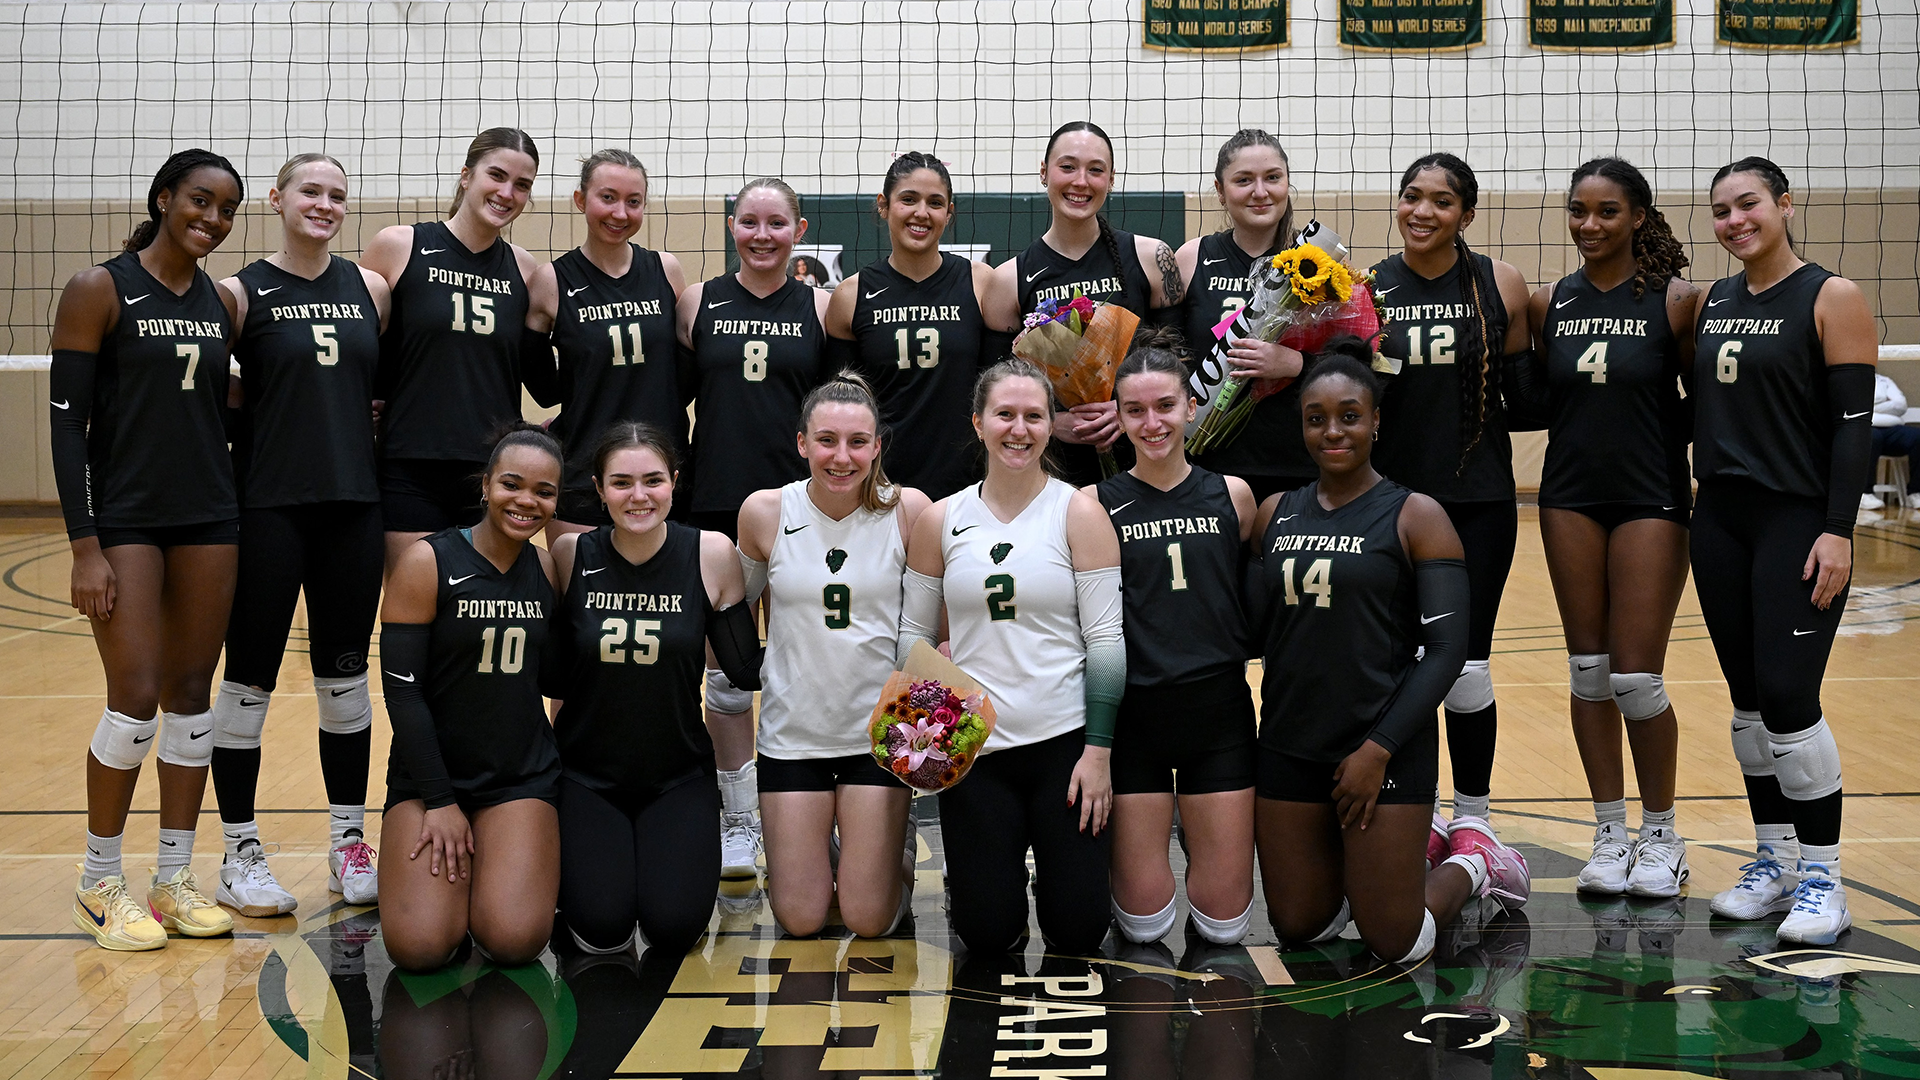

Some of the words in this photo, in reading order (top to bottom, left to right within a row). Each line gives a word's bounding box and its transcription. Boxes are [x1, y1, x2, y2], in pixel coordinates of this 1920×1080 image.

[1177, 21, 1199, 36] NAIA
[1204, 21, 1235, 36] WORLD
[1238, 20, 1272, 36] SERIES
[1372, 19, 1394, 34] NAIA
[1397, 18, 1429, 33] WORLD
[1432, 18, 1467, 33] SERIES
[1535, 18, 1557, 33] 1999
[1564, 18, 1586, 33] NAIA
[1588, 17, 1652, 33] INDEPENDENT
[428, 266, 513, 297] POINTPARK
[1035, 277, 1123, 304] POINTPARK
[1207, 276, 1255, 293] POINT
[270, 303, 364, 321] POINTPARK
[450, 291, 496, 336] 15
[578, 299, 662, 323] POINTPARK
[873, 305, 962, 325] POINTPARK
[136, 319, 223, 339] POINTPARK
[712, 319, 803, 338] POINTPARK
[1555, 317, 1648, 337] POINTPARK
[1702, 318, 1785, 335] POINTPARK
[310, 323, 340, 367] 5
[608, 322, 646, 367] 11
[894, 327, 942, 371] 13
[1406, 324, 1457, 367] 12
[175, 342, 202, 392] 7
[743, 339, 769, 383] 8
[1576, 340, 1610, 385] 4
[1715, 340, 1744, 385] 6
[1121, 517, 1221, 543] POINTPARK
[1271, 535, 1365, 556] POINTPARK
[1165, 541, 1190, 593] 1
[983, 572, 1018, 623] 2
[1281, 556, 1334, 610] 14
[456, 600, 545, 619] POINTPARK
[584, 592, 684, 613] POINTPARK
[822, 582, 853, 631] 9
[476, 625, 528, 675] 10
[599, 617, 664, 666] 25
